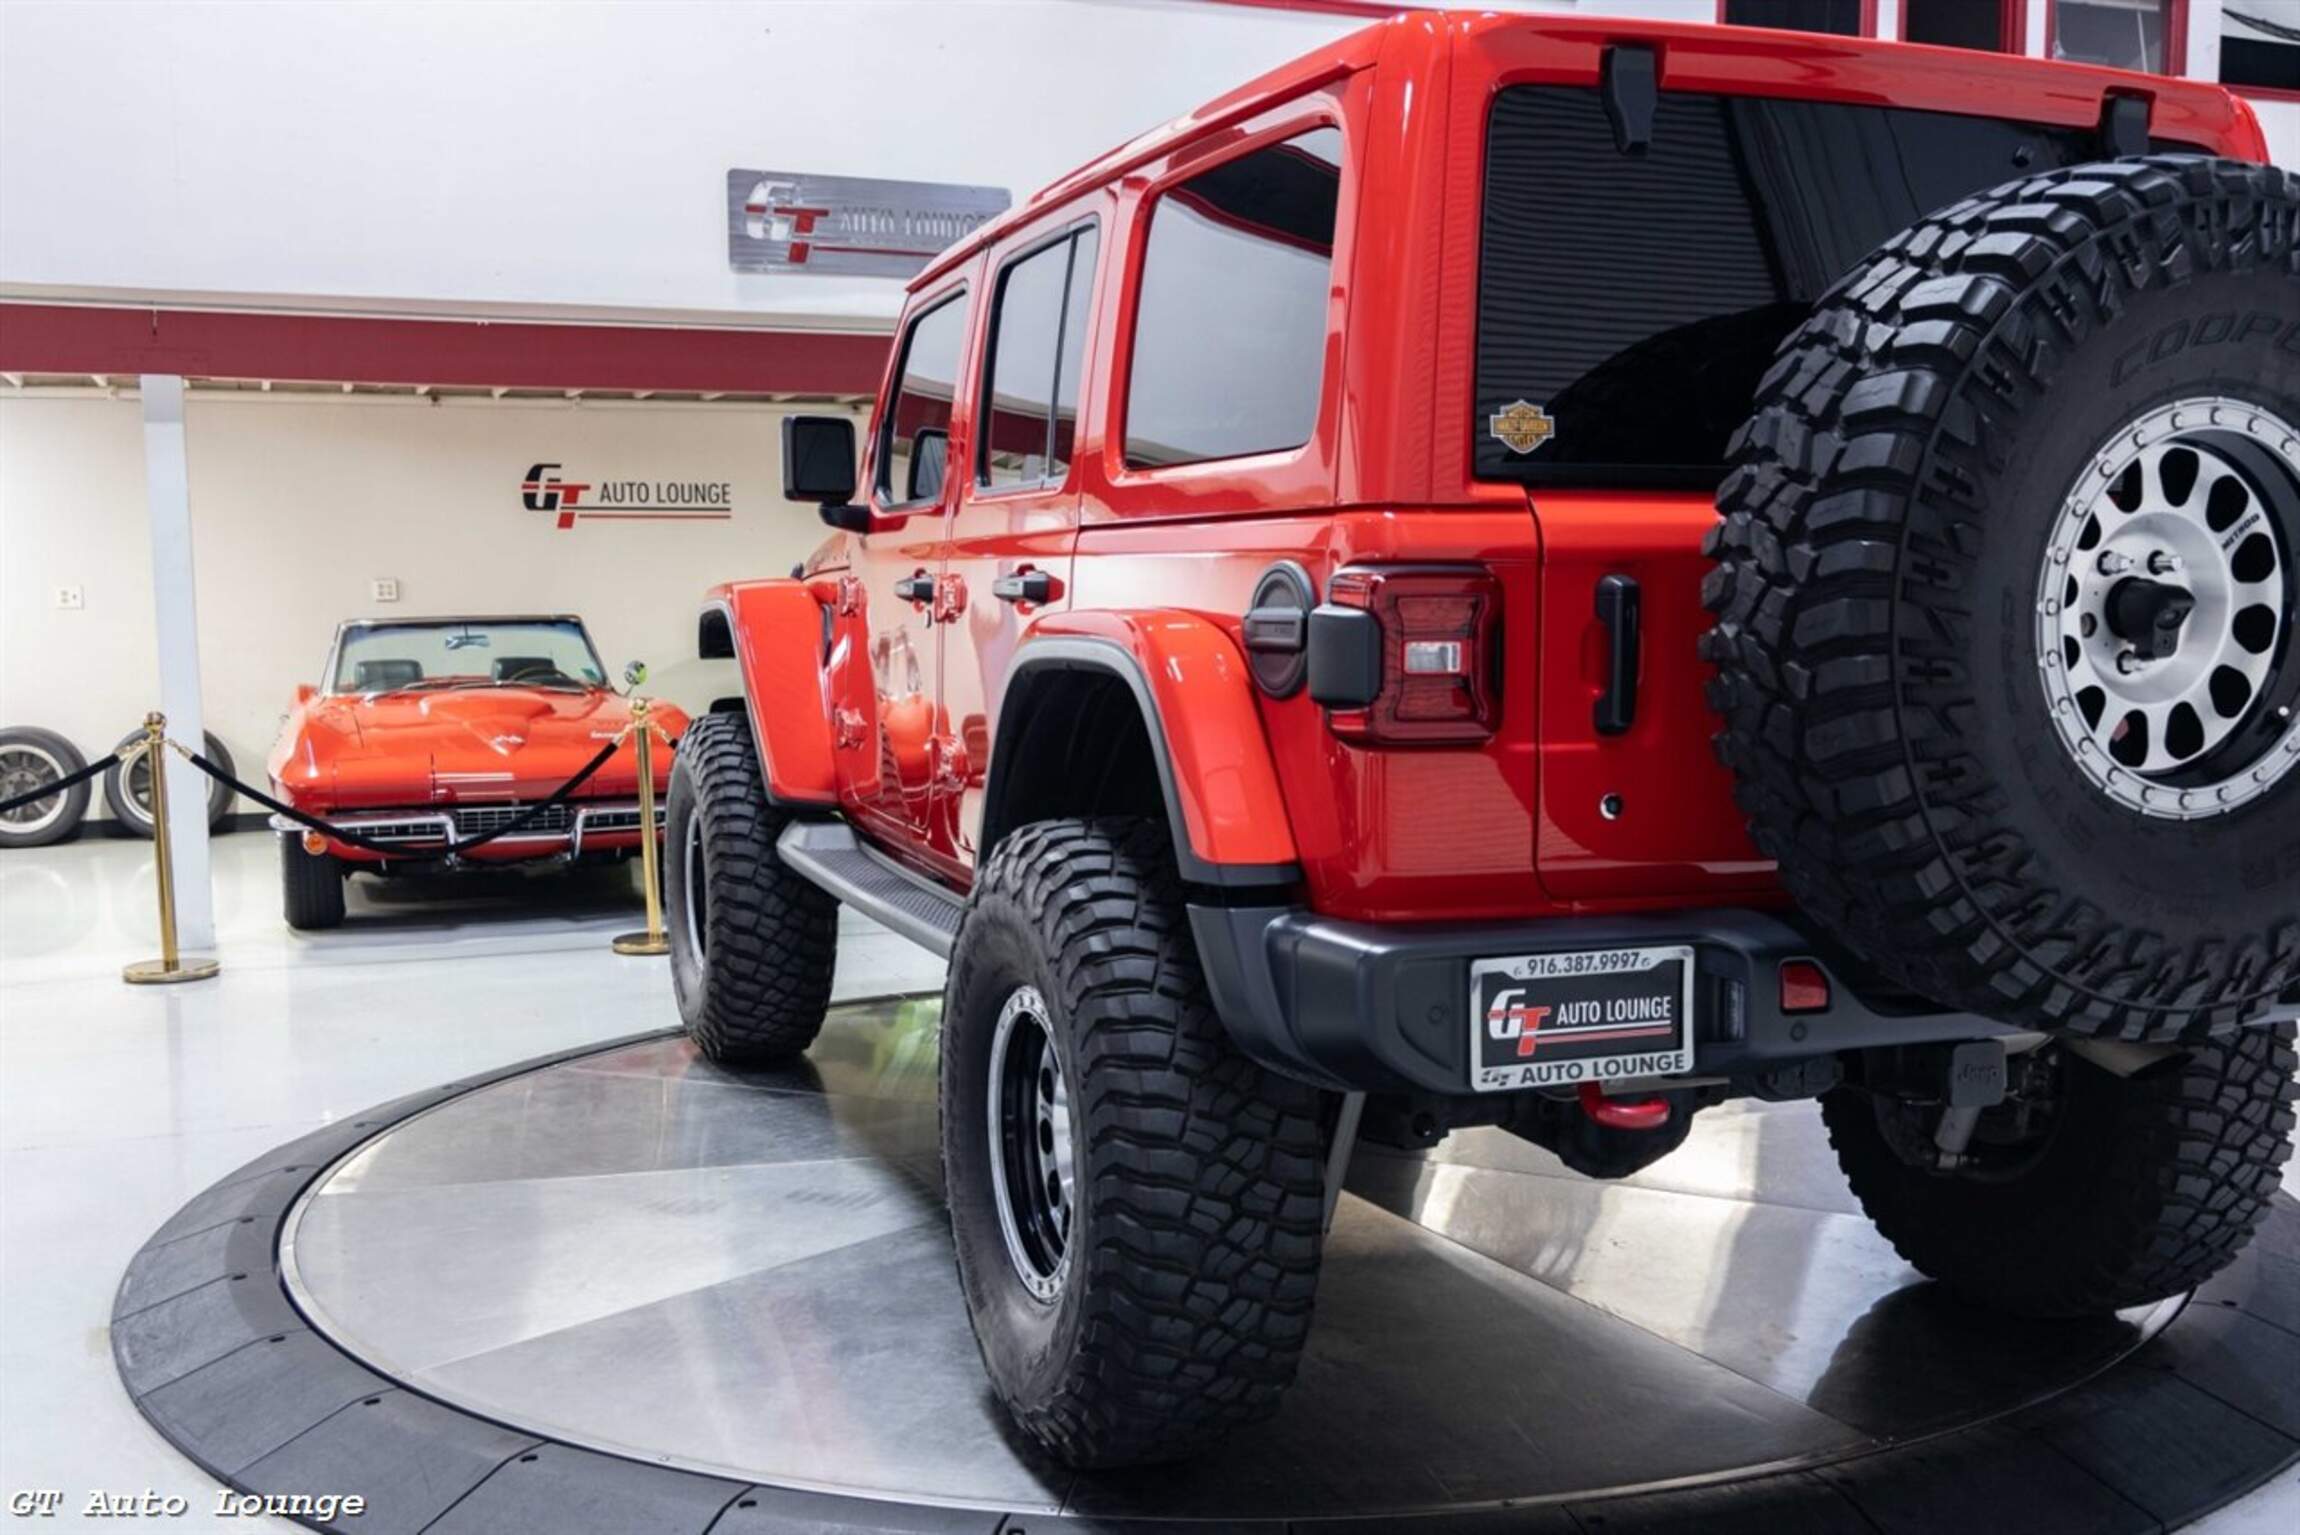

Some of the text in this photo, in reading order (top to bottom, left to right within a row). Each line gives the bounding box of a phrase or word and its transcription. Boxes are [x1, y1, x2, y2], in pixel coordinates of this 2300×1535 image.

[745, 180, 829, 263] GT
[903, 209, 987, 239] LOUNG
[521, 463, 731, 529] GT AUTO LOUNGE
[1527, 952, 1641, 976] 916.387.9997
[1487, 988, 1672, 1057] GT AUTO LOUNGE
[1519, 1062, 1584, 1084] AUTO
[1592, 1053, 1686, 1078] LOUNGE
